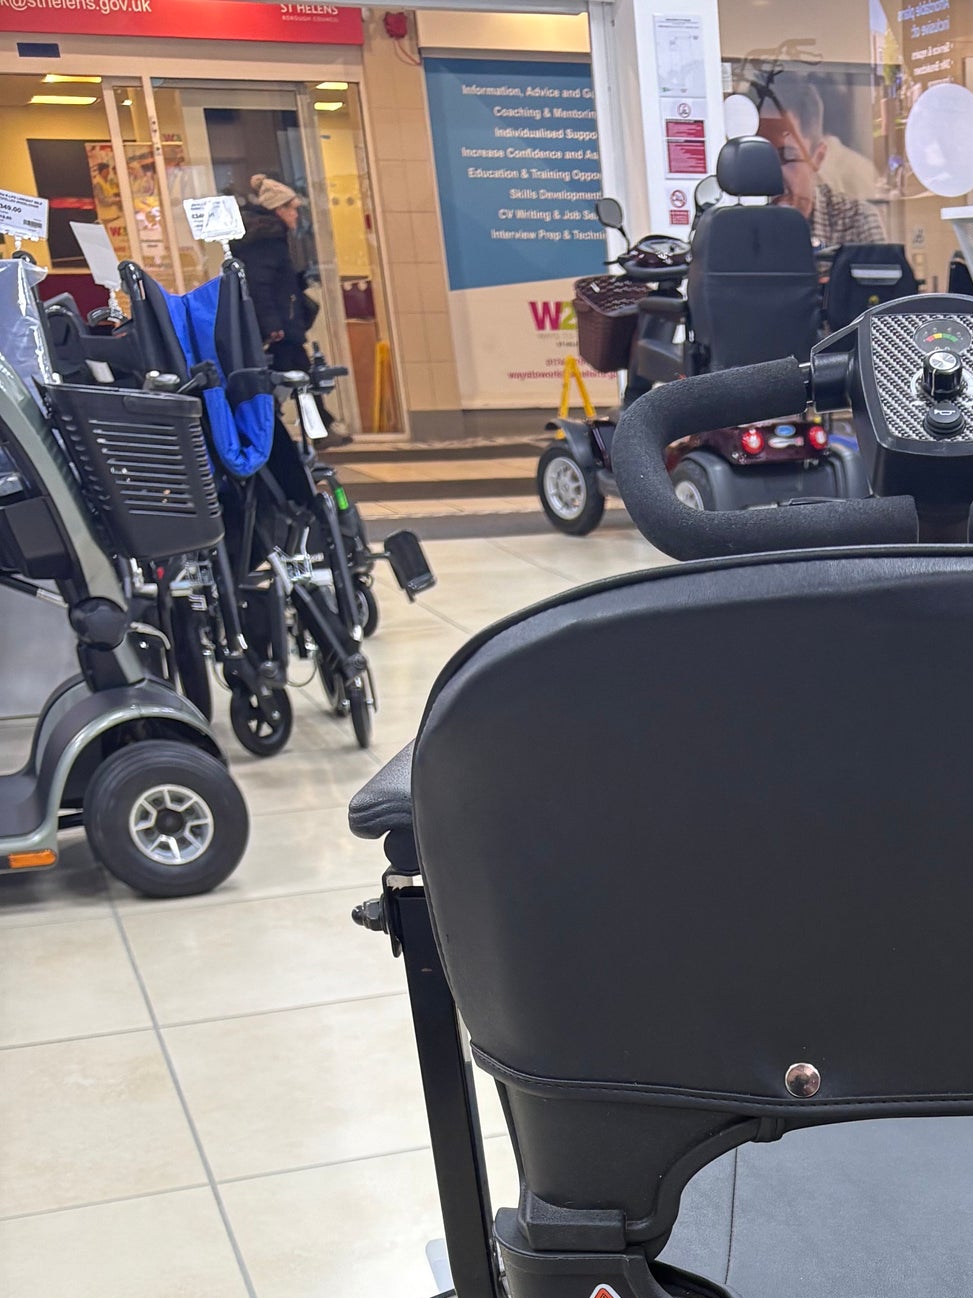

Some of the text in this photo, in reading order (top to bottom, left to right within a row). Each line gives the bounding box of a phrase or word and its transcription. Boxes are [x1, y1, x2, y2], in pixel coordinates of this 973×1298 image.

[297, 4, 338, 15] HELENS
[525, 86, 560, 98] Advice
[561, 88, 581, 98] and
[581, 88, 595, 98] G
[493, 106, 542, 120] Coaching
[543, 107, 551, 118] &
[494, 127, 564, 139] Individualised
[461, 146, 505, 158] Increase
[506, 147, 562, 159] Confidence
[563, 149, 583, 159] and
[467, 167, 519, 179] Education
[520, 168, 529, 179] &
[530, 168, 571, 182] Training
[509, 188, 538, 199] Skills
[498, 208, 514, 219] CV
[515, 209, 551, 221] Writing
[552, 209, 561, 220] &
[562, 209, 581, 220] Job
[490, 229, 537, 239] Interview
[537, 229, 561, 242] Prep
[562, 230, 571, 239] &
